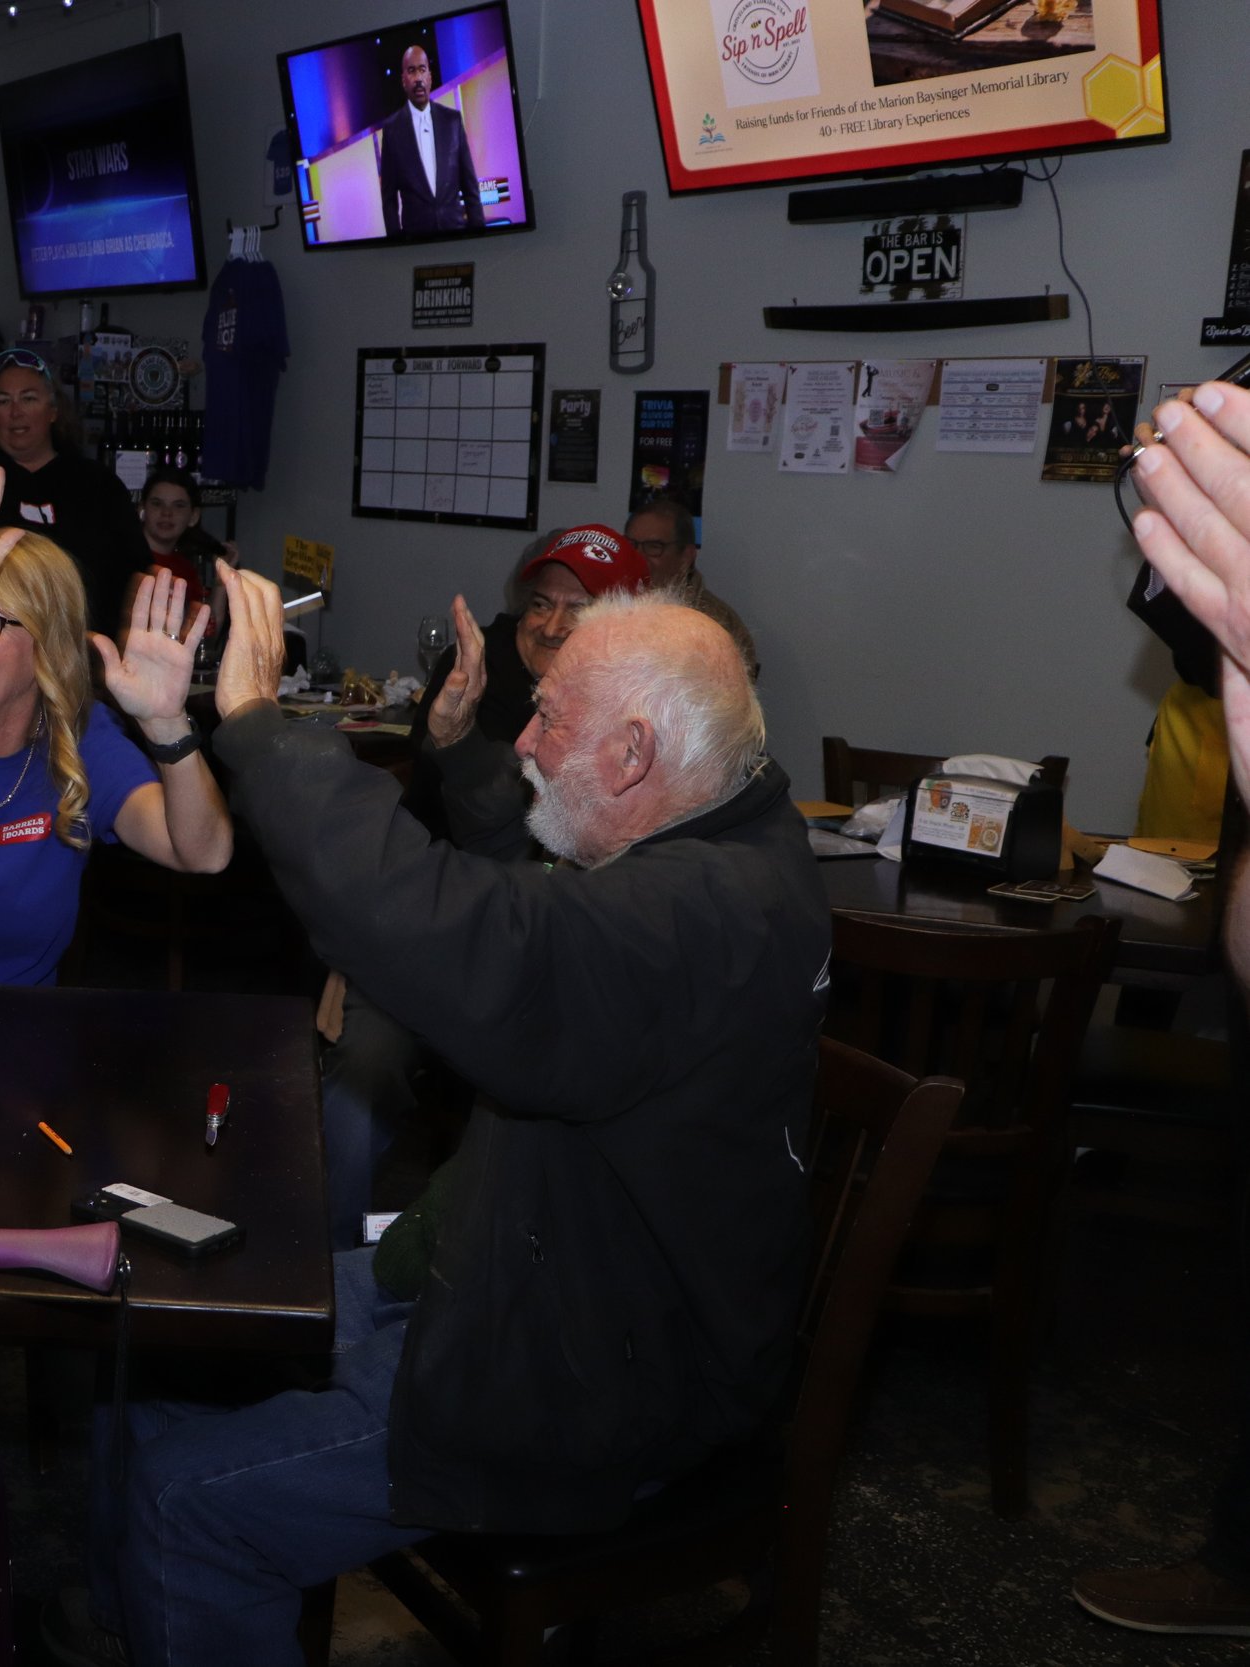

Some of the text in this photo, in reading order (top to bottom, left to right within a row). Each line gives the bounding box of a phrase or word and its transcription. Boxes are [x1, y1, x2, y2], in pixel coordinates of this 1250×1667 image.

[722, 35, 748, 63] Sip
[764, 6, 807, 51] Spell
[741, 61, 760, 77] FRIENDS
[779, 51, 794, 72] LIBRARY
[735, 71, 1071, 129] Raising funds for Friends of the Marion Baysinger Memorial Library
[819, 107, 971, 137] 40+ FREE Library Experiences
[66, 141, 130, 181] STAR WARS
[478, 179, 498, 192] GAME
[880, 230, 944, 248] THE BAR IS
[865, 244, 958, 284] OPEN
[415, 287, 471, 308] DRINKING
[412, 358, 483, 371] DRINK IT FORWARD
[559, 399, 592, 418] Party
[641, 400, 675, 411] TRIVIA
[640, 420, 655, 429] OUR
[639, 436, 674, 447] FOR FREE
[2, 816, 45, 833] BARRELS
[5, 825, 45, 841] BOARDS
